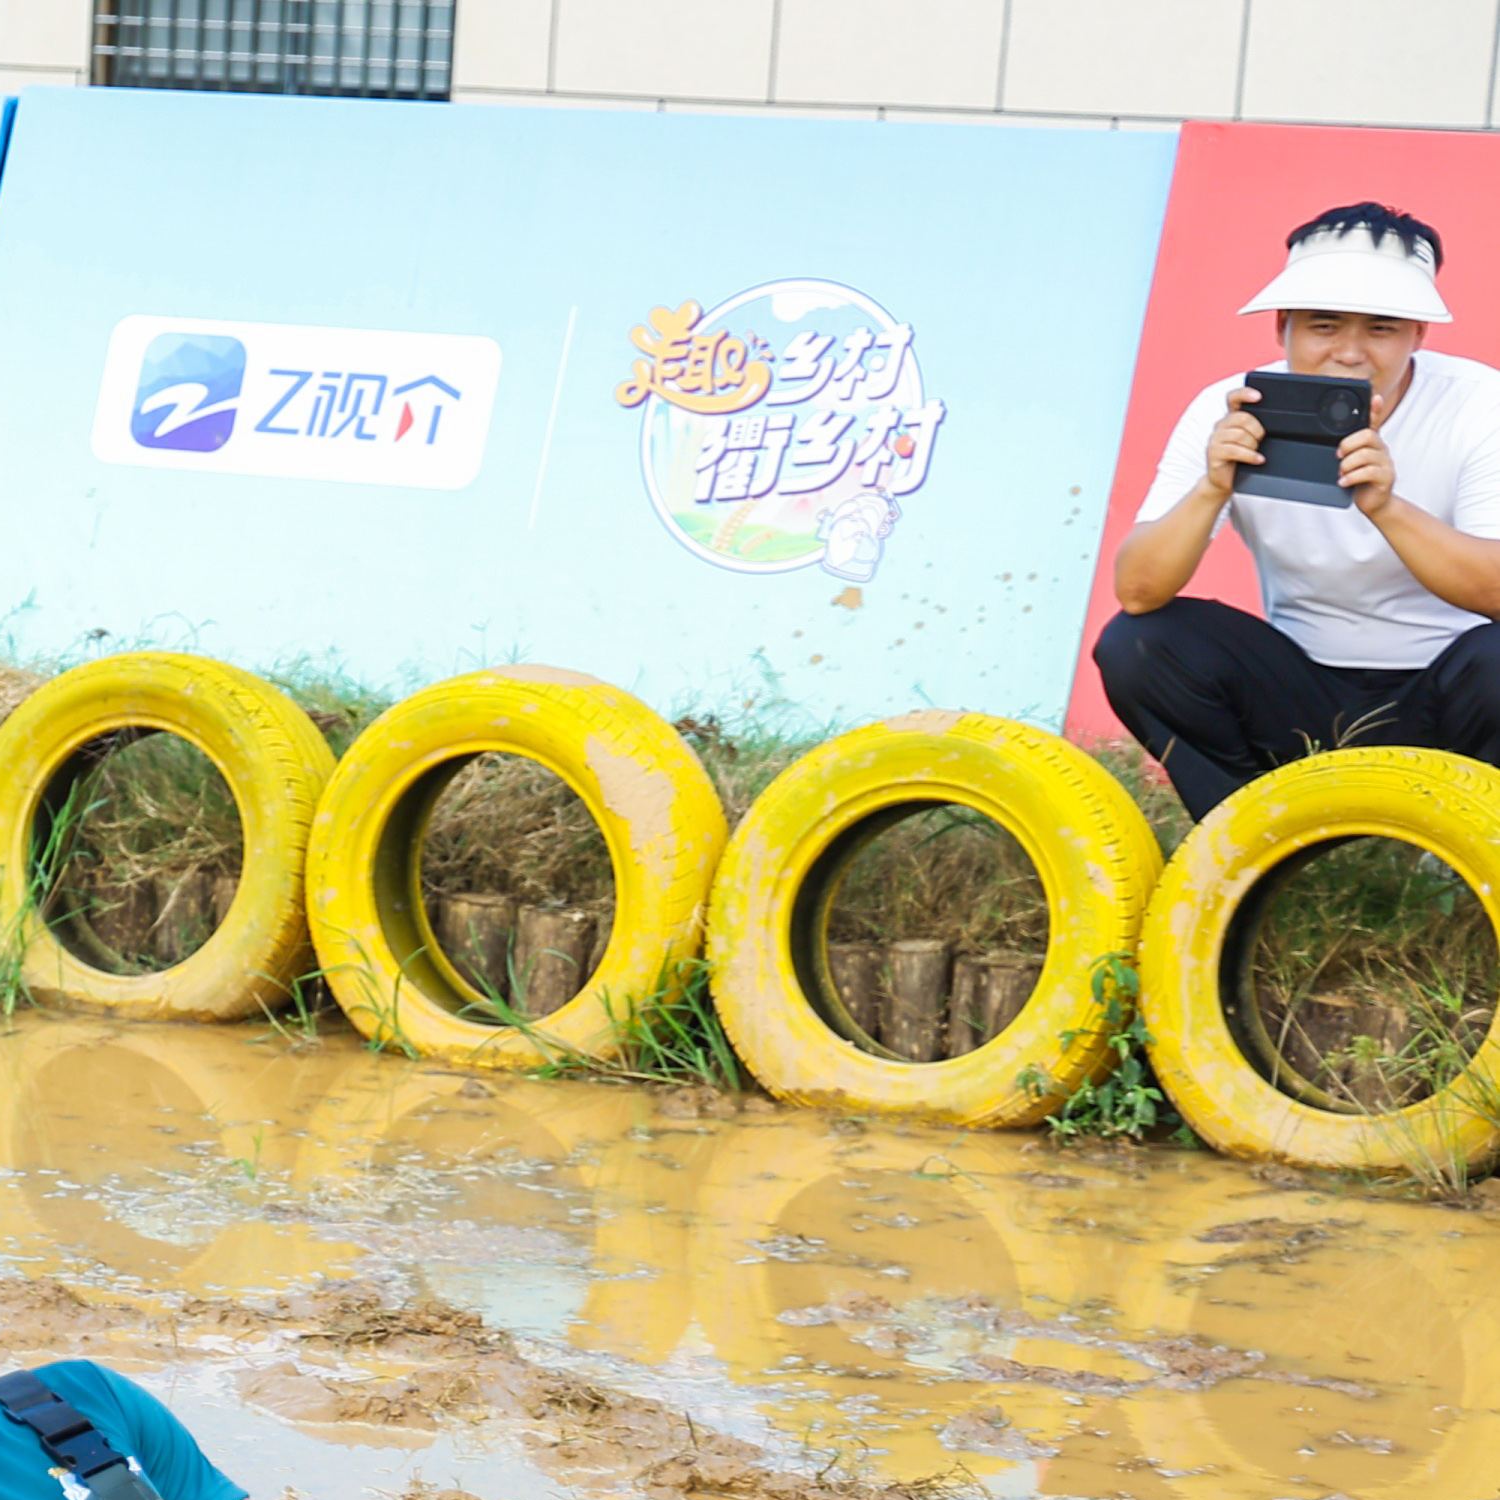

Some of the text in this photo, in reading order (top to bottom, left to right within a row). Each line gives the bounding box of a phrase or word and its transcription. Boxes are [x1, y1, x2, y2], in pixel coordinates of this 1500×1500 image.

[614, 298, 915, 416] 趣乡村
[253, 368, 462, 446] Z视介
